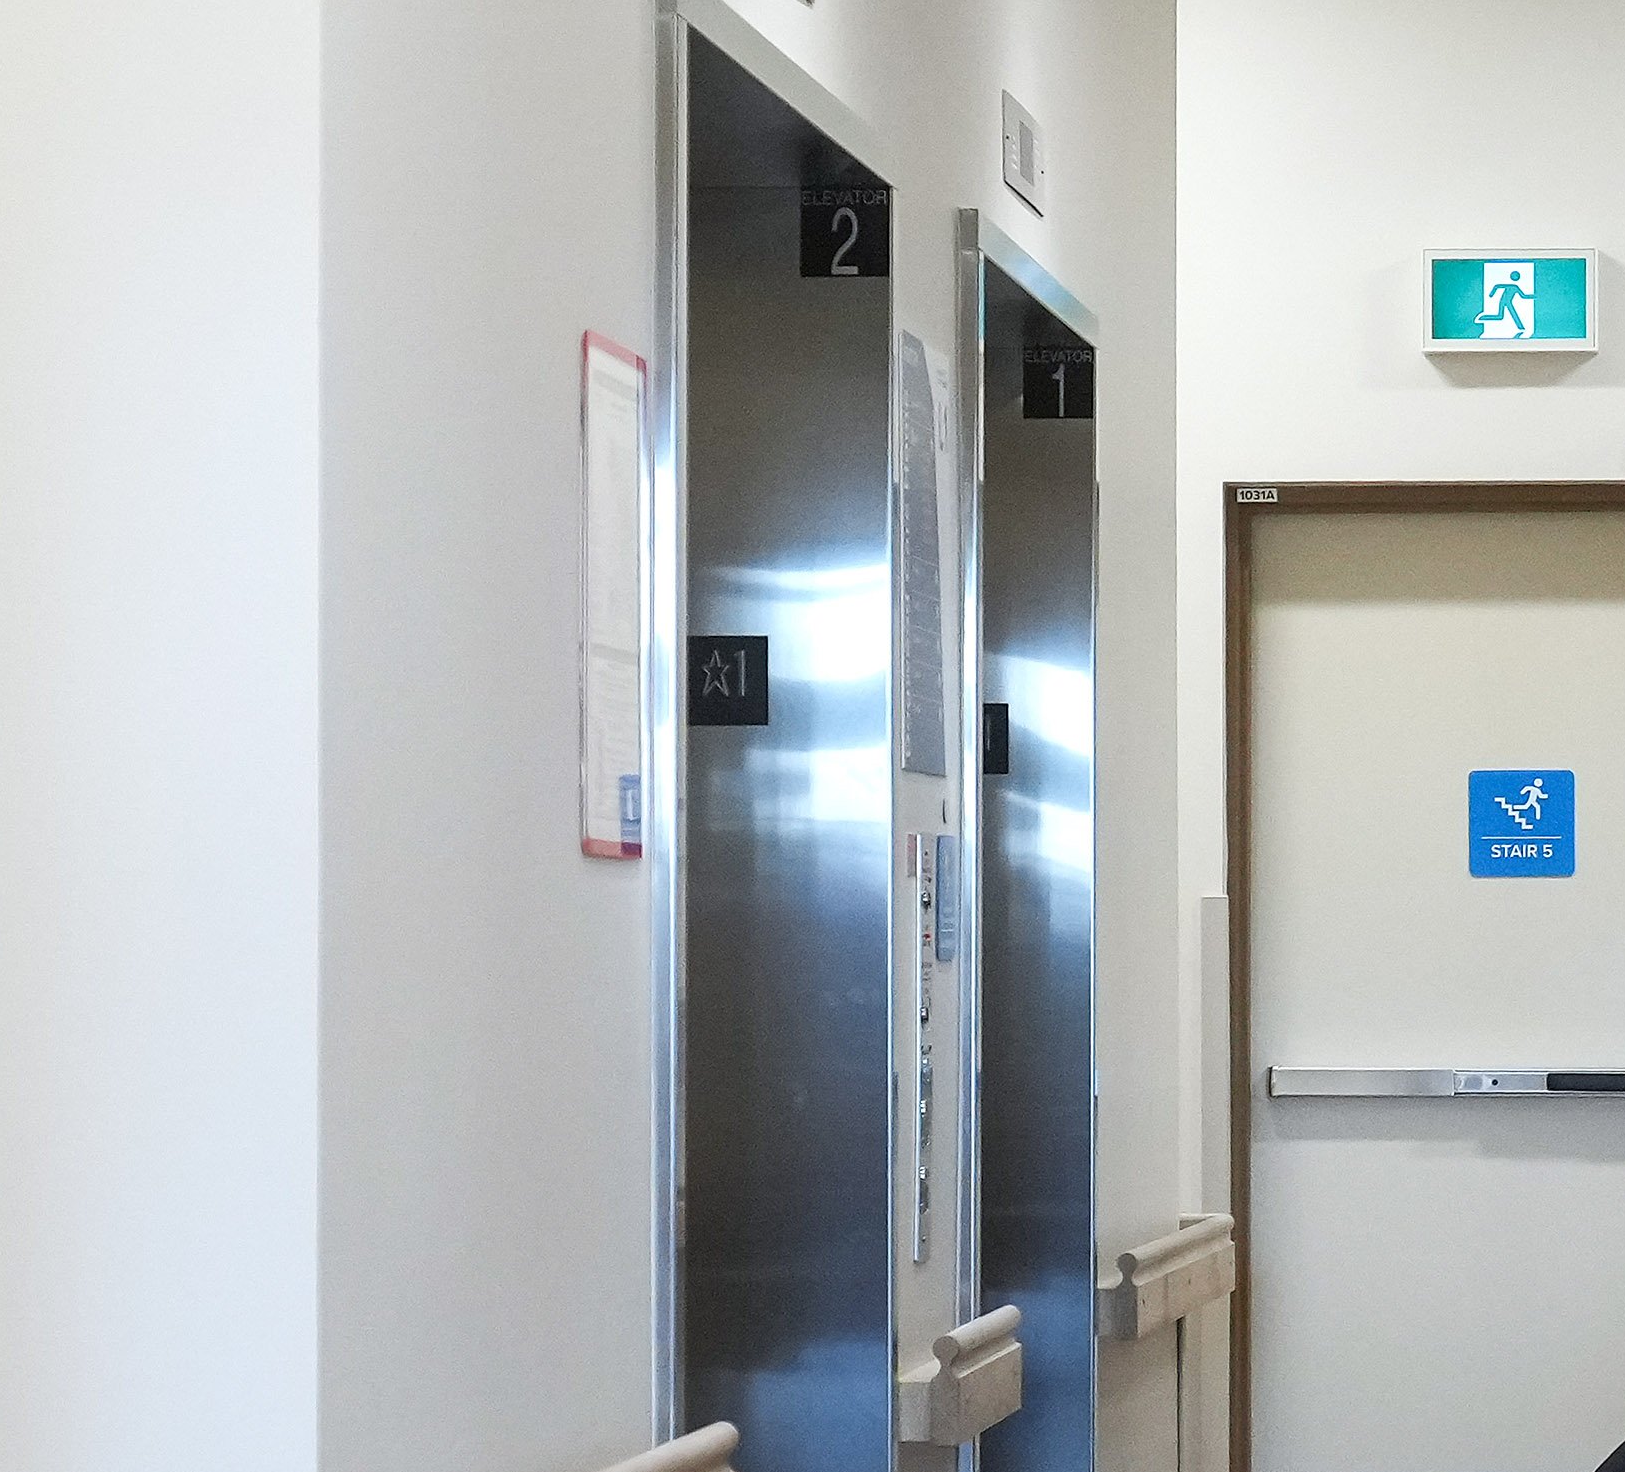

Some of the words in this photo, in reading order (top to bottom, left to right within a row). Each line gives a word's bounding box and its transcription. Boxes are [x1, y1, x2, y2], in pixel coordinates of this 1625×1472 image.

[802, 189, 887, 205] ELEVATOR
[831, 207, 859, 275] 2
[1024, 350, 1092, 363] ELEVATOR
[1052, 363, 1065, 417] 1
[1239, 490, 1275, 500] 1031A
[1491, 844, 1538, 858] STAIR
[1543, 844, 1553, 858] 5
